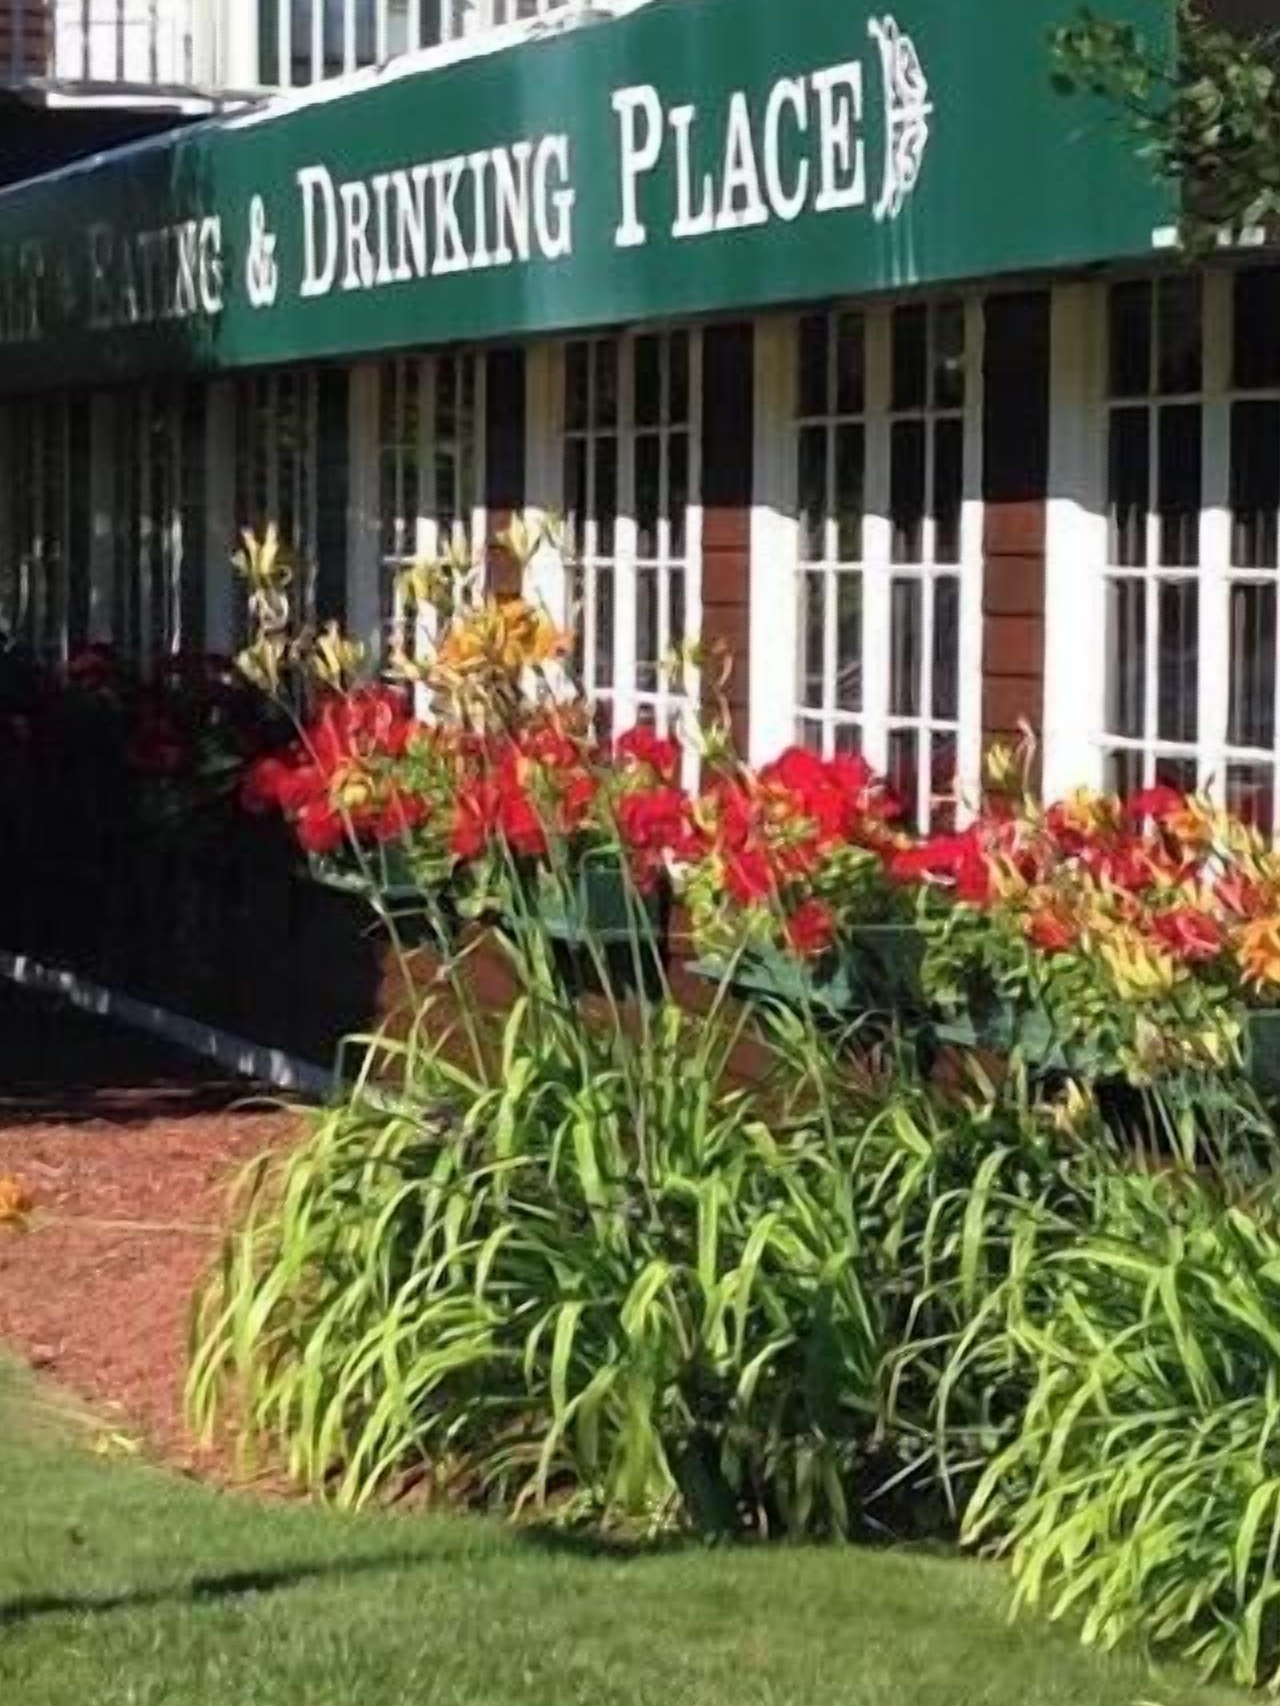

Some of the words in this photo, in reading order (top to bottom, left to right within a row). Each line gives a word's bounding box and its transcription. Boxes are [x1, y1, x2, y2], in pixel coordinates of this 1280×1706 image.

[245, 194, 278, 308] &
[297, 135, 576, 297] DRINKING
[612, 62, 866, 247] PLACE
